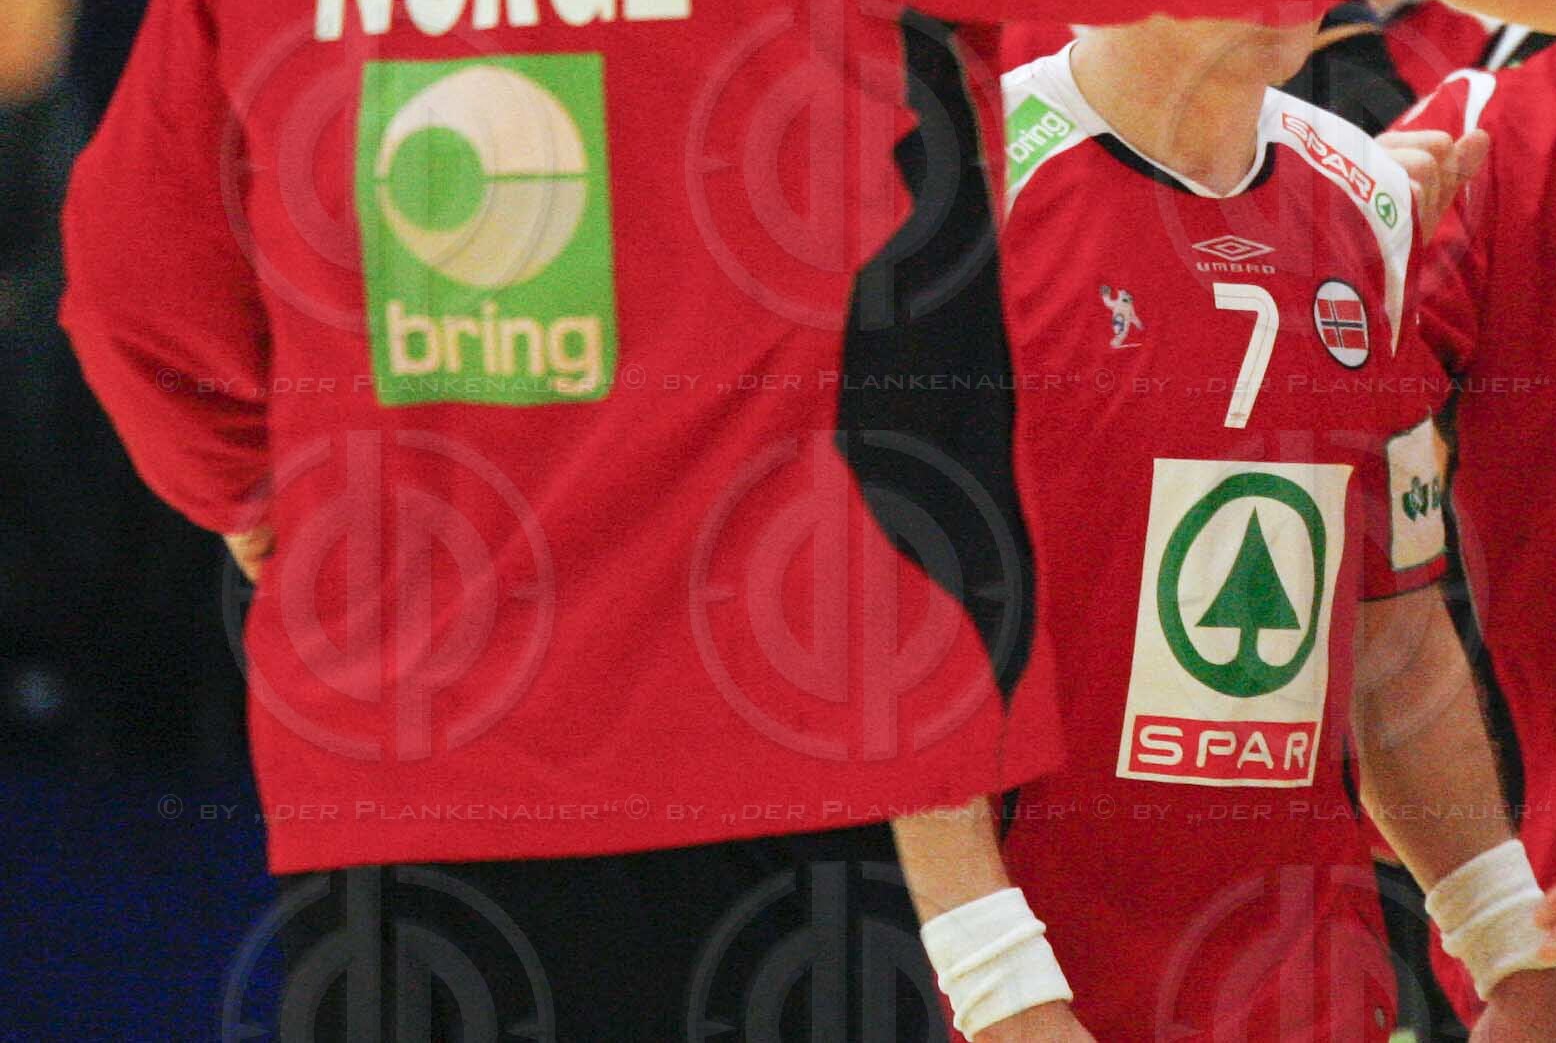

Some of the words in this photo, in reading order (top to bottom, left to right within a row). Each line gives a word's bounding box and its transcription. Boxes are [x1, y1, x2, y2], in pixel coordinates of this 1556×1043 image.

[1282, 115, 1372, 199] SPAR
[386, 297, 603, 396] bring
[1211, 281, 1281, 430] 7
[1137, 723, 1310, 772] SPAR
